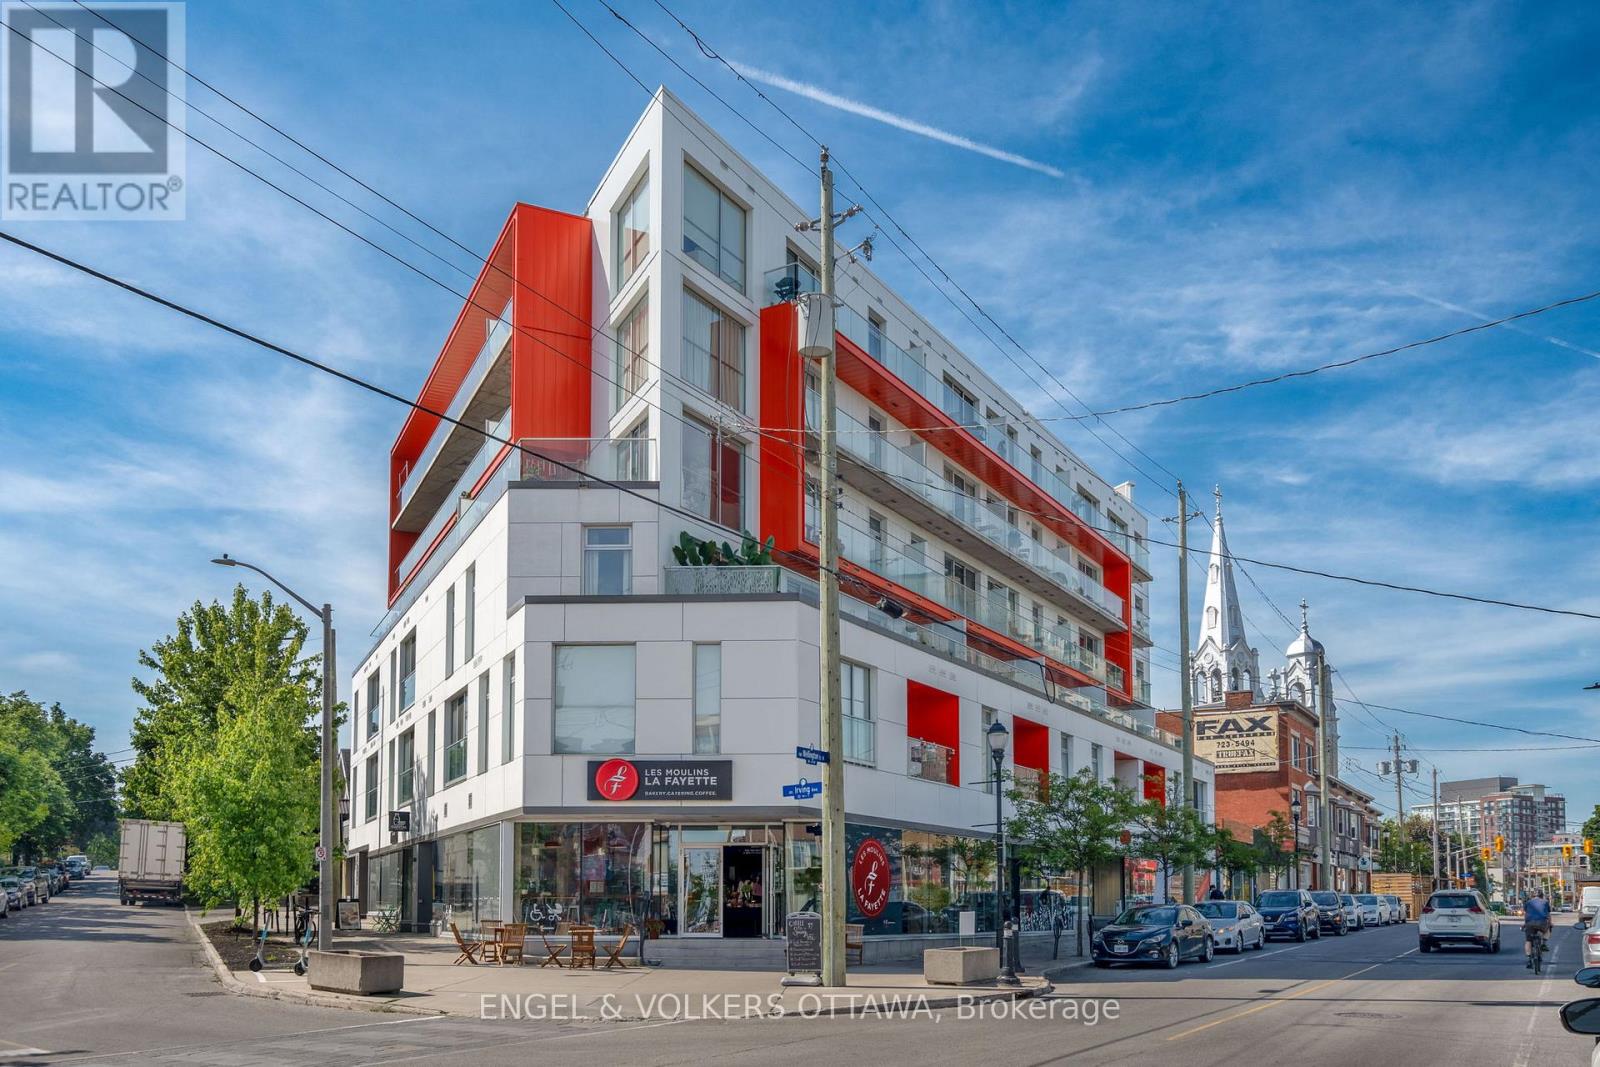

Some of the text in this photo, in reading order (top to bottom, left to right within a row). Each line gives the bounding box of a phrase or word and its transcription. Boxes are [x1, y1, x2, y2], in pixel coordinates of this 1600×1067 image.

[1196, 715, 1274, 736] FAX
[1216, 739, 1255, 748] 723-5494
[644, 776, 718, 786] LA FAYETTE
[858, 845, 885, 866] LES MOULINS
[857, 887, 886, 912] LA FAYETTE
